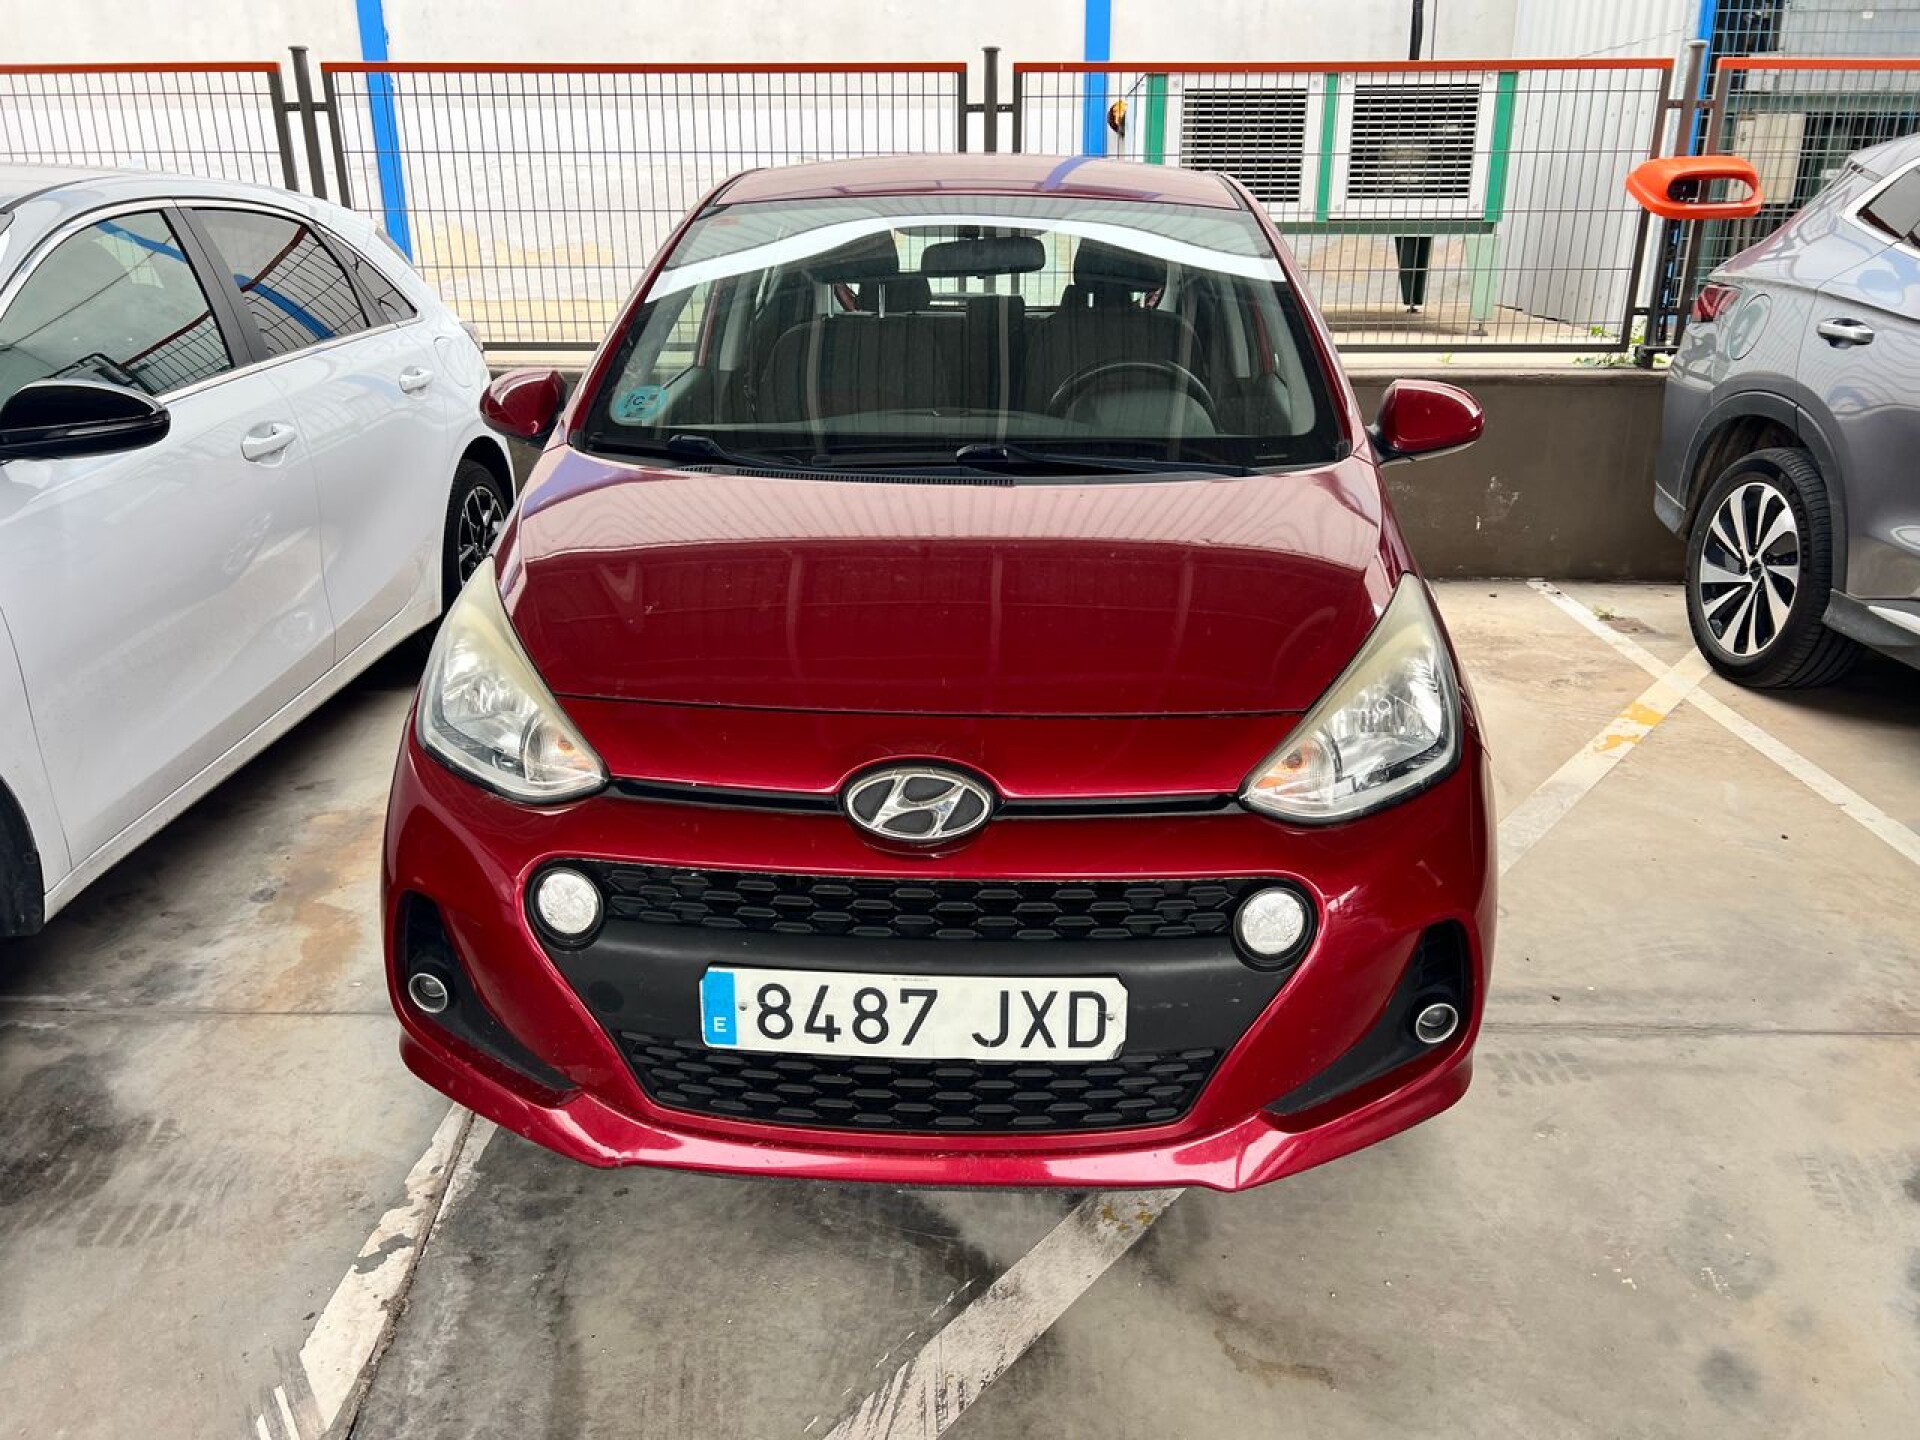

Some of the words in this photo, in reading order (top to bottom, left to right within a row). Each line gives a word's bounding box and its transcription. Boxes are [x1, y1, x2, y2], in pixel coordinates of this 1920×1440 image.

[713, 1016, 727, 1033] E
[757, 983, 938, 1046] 8487
[971, 990, 1107, 1048] JXD
